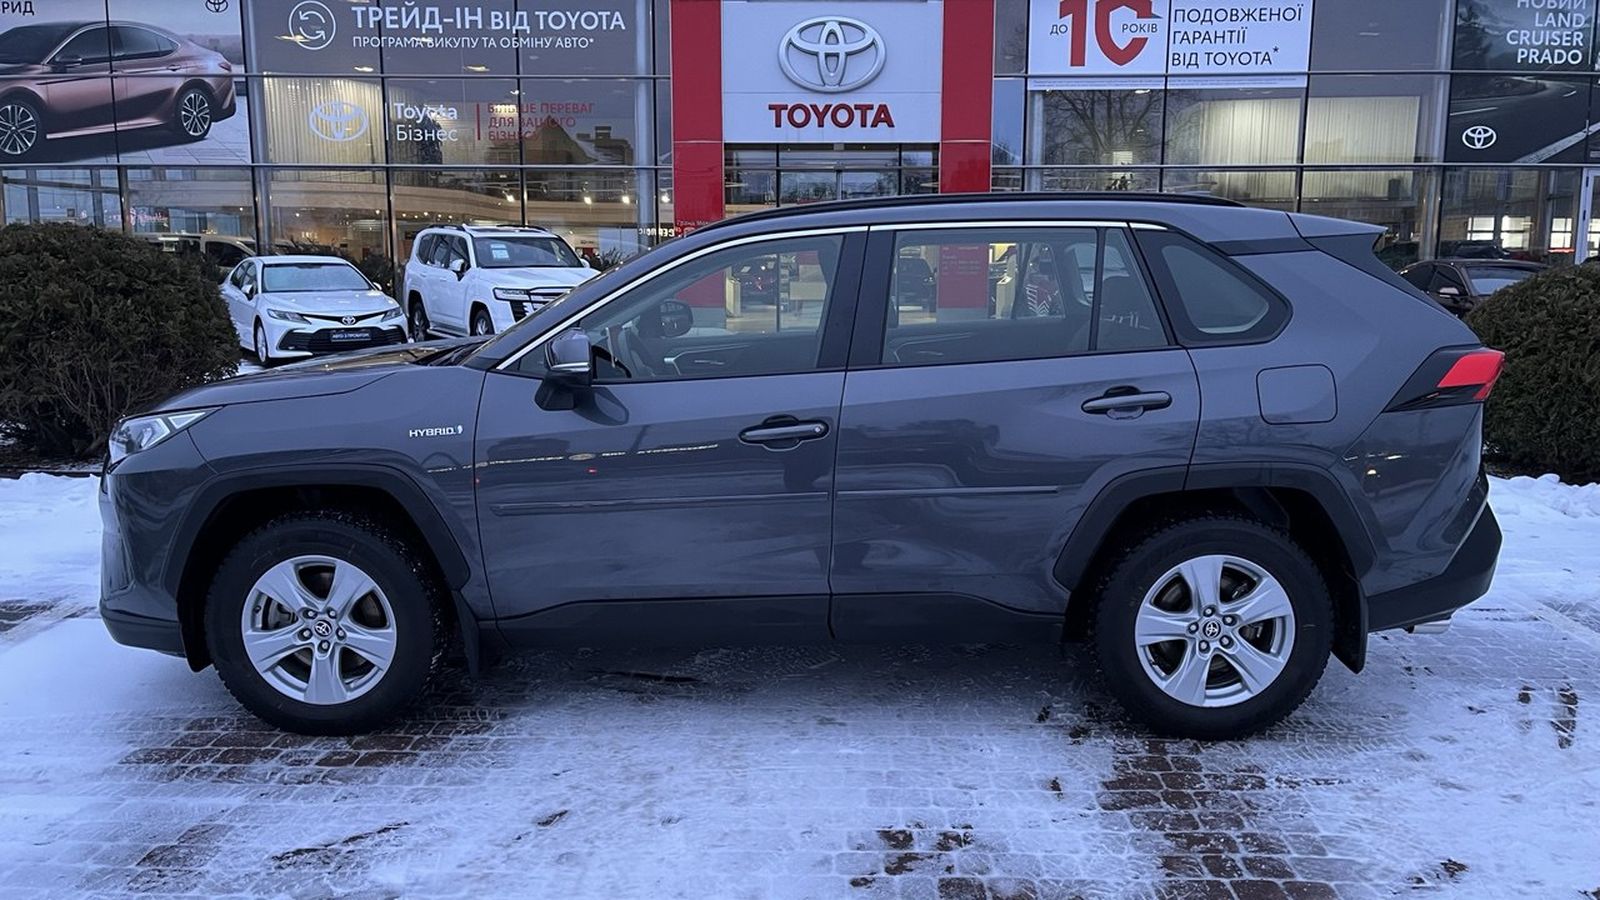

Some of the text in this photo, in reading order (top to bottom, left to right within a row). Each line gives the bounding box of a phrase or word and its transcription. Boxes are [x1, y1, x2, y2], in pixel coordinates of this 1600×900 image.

[351, 1, 626, 34] ТРЕЙД-ІН ВІД TOYOTA
[1174, 3, 1304, 25] ПОДОВЖЕНОЇ
[1535, 12, 1586, 28] LAND
[1049, 24, 1068, 35] ДО
[1121, 23, 1158, 33] РОКІВ
[1172, 26, 1248, 45] ГАРАНТІЇ
[1506, 29, 1583, 46] CRUISER
[352, 36, 424, 48] ПРОГРАМА
[427, 36, 479, 48] ВИКУПУ
[481, 37, 497, 48] ТА
[500, 37, 552, 48] ОБМІНУ
[1171, 52, 1199, 69] ВІД
[1517, 48, 1582, 65] PRADO
[394, 103, 458, 123] Toyota
[541, 102, 595, 114] ПЕРЕВАГ
[768, 103, 895, 128] TOYOTA
[488, 117, 514, 129] ДЛЯ
[396, 124, 459, 142] Бізнес
[409, 427, 456, 438] HYBRID
